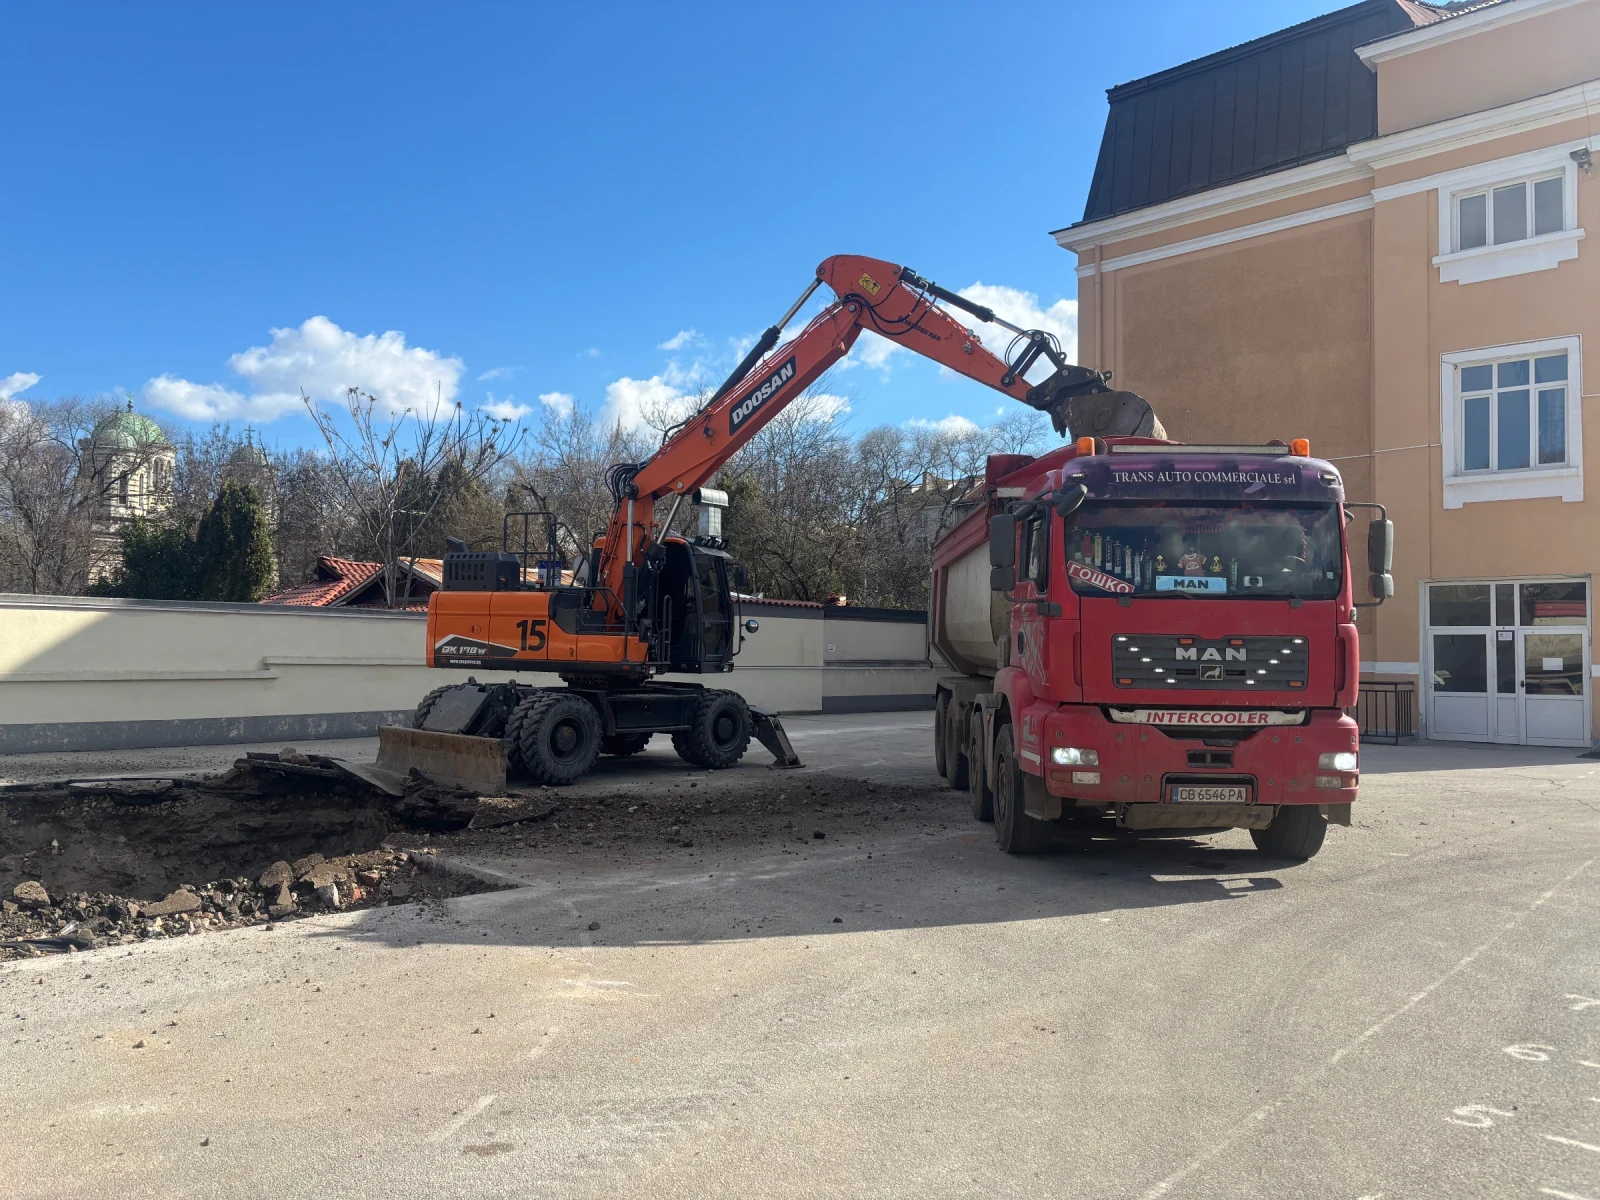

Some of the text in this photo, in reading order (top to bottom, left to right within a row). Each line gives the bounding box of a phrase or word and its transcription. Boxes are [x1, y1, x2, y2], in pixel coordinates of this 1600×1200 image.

[732, 362, 794, 425] DOOSAN
[1113, 471, 1296, 485] TRANS AUTO COMMERCIALE srl
[1068, 563, 1130, 593] ГОШКО
[1173, 578, 1209, 589] MAN
[516, 619, 547, 652] 15
[1175, 647, 1247, 661] MAN
[1146, 711, 1269, 724] INTERCOOLER
[1180, 788, 1196, 800] CB
[1198, 788, 1227, 800] 6546
[1228, 788, 1244, 800] PA
